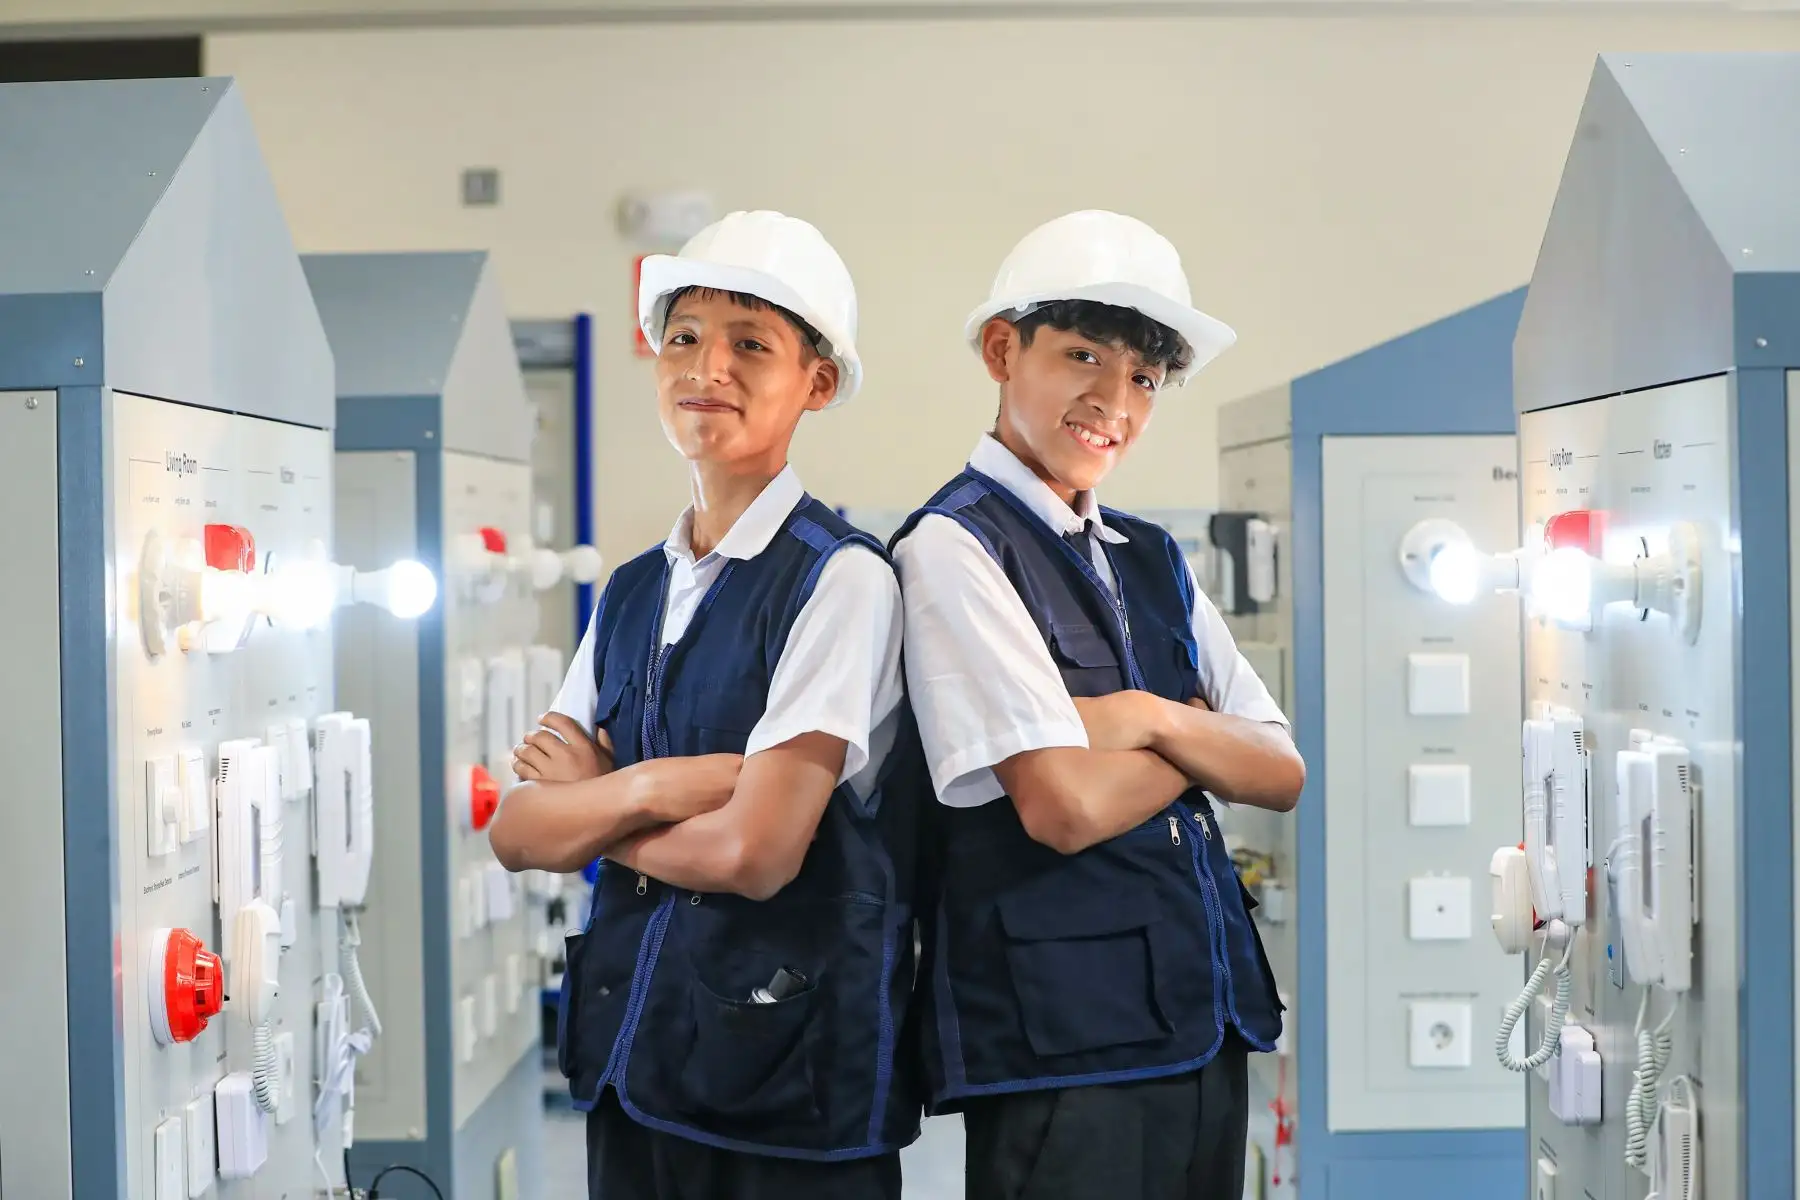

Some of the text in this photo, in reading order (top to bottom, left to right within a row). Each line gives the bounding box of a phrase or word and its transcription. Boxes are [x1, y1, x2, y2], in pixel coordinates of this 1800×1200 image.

[165, 450, 197, 478] Living Room
[1549, 447, 1573, 471] Living Room
